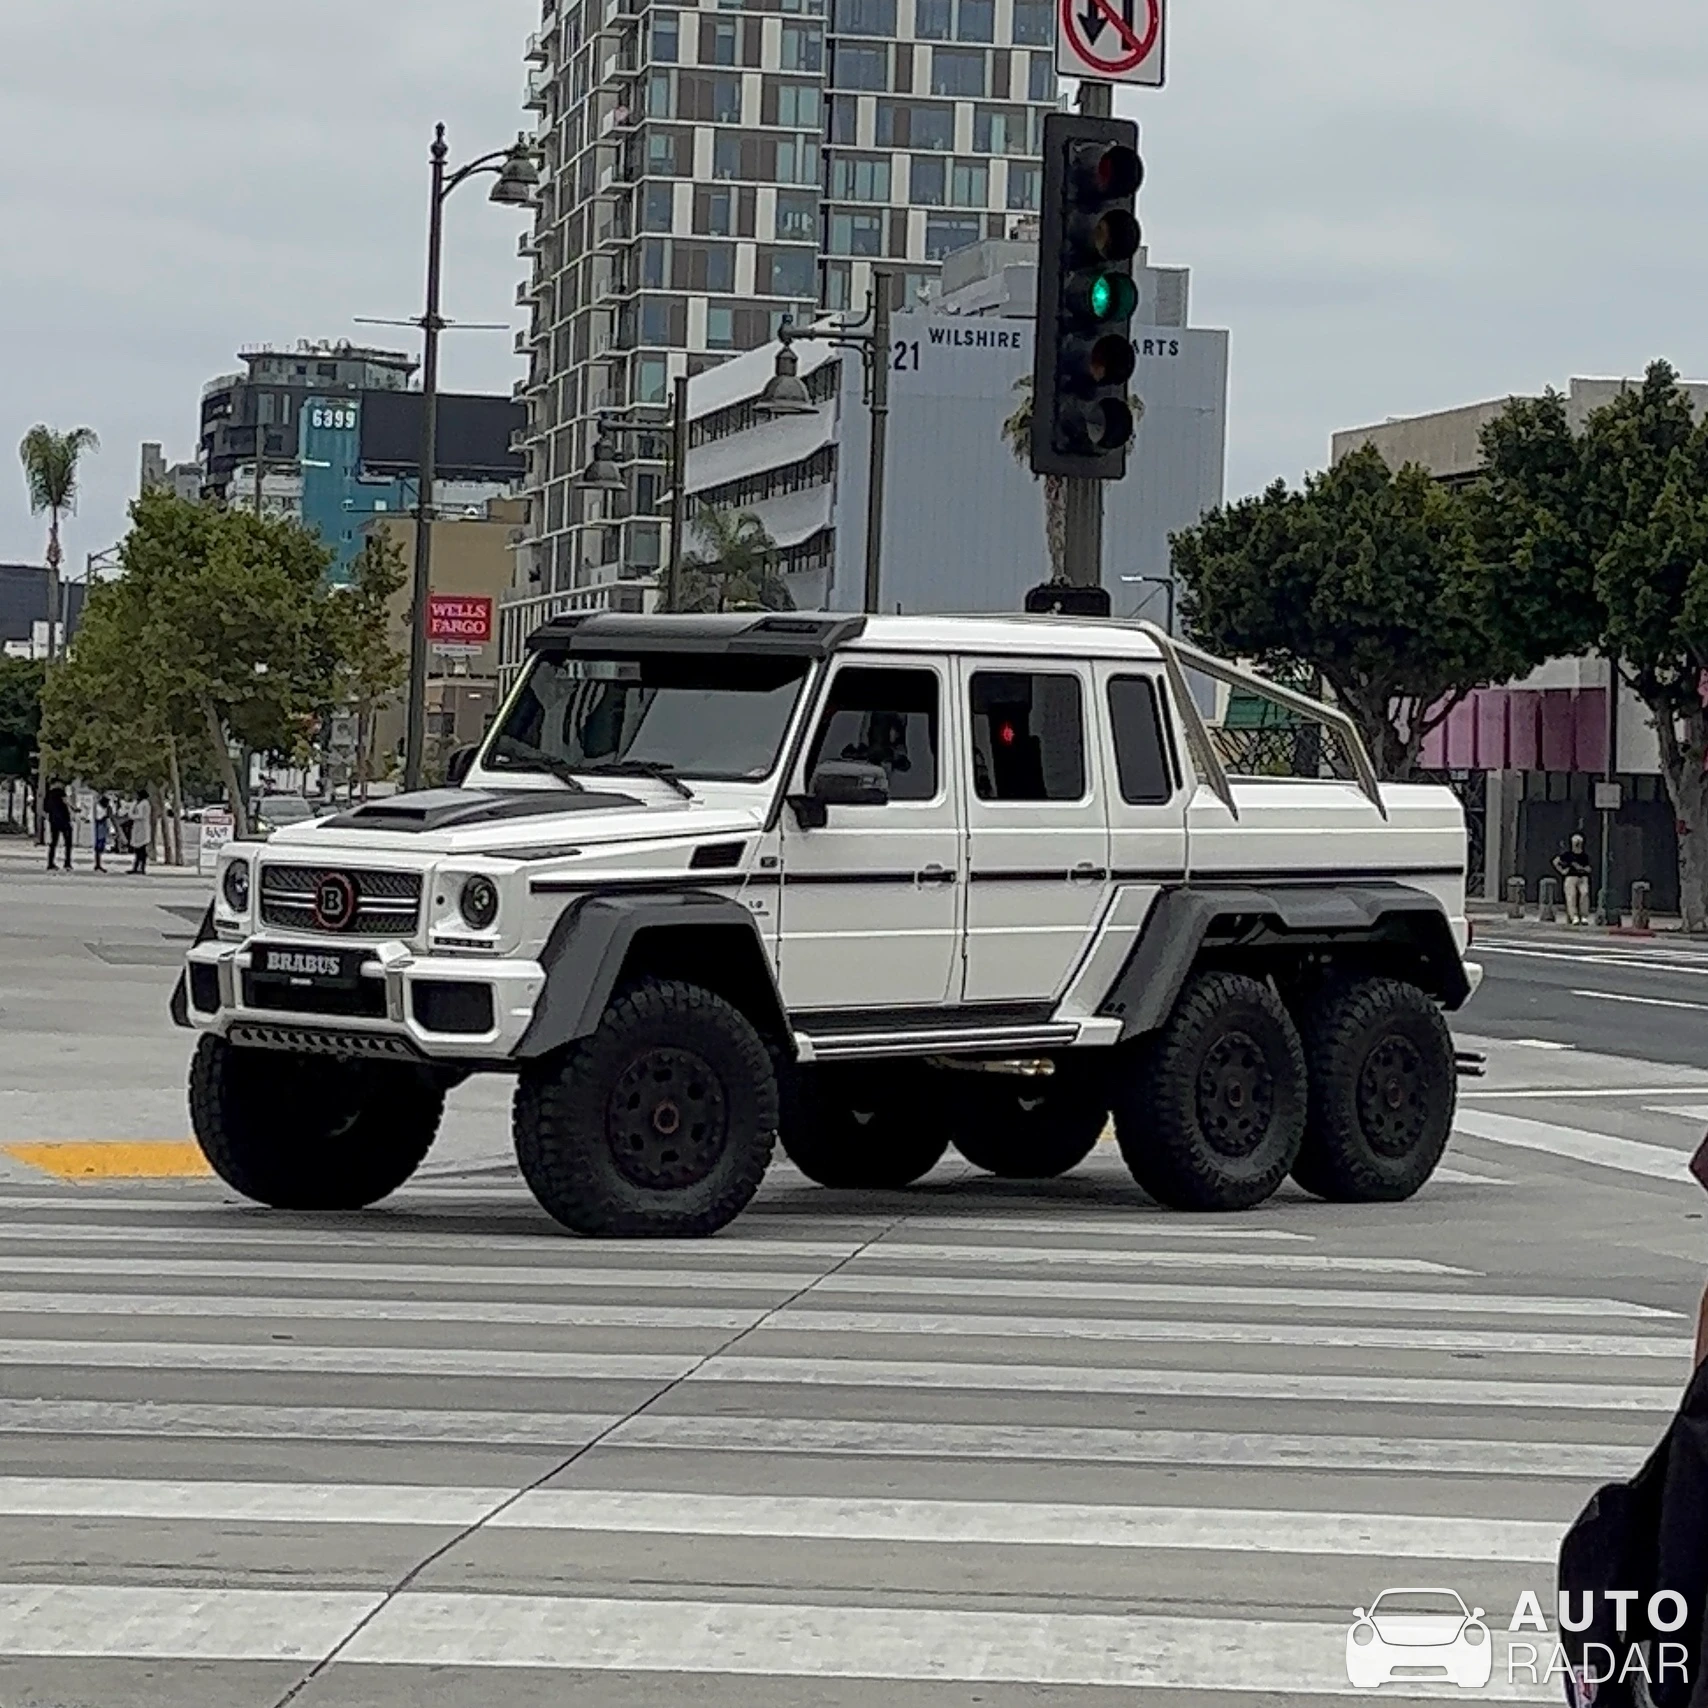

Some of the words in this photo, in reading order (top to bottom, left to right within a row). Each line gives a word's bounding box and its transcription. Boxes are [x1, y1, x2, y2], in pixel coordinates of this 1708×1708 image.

[928, 326, 1021, 348] WILSHIRE
[887, 340, 919, 371] 21
[431, 603, 486, 618] WELLS
[432, 618, 486, 635] FARGO
[321, 886, 343, 915] B
[267, 951, 340, 976] BRABUS
